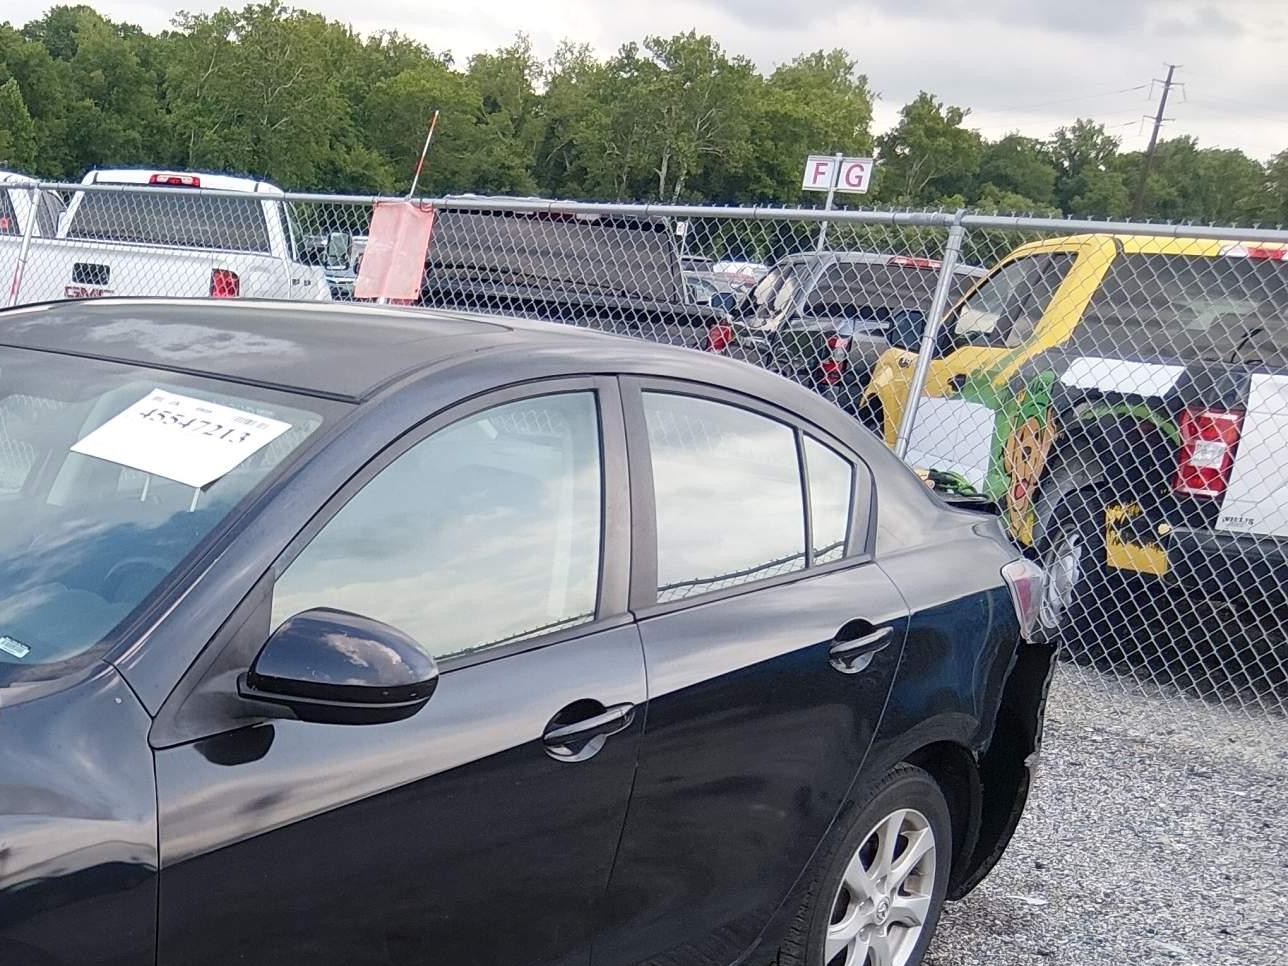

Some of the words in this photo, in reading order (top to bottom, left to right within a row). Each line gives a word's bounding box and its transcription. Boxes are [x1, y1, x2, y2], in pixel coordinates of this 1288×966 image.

[813, 162, 828, 185] F
[845, 163, 864, 188] G
[140, 408, 250, 443] 45547213
